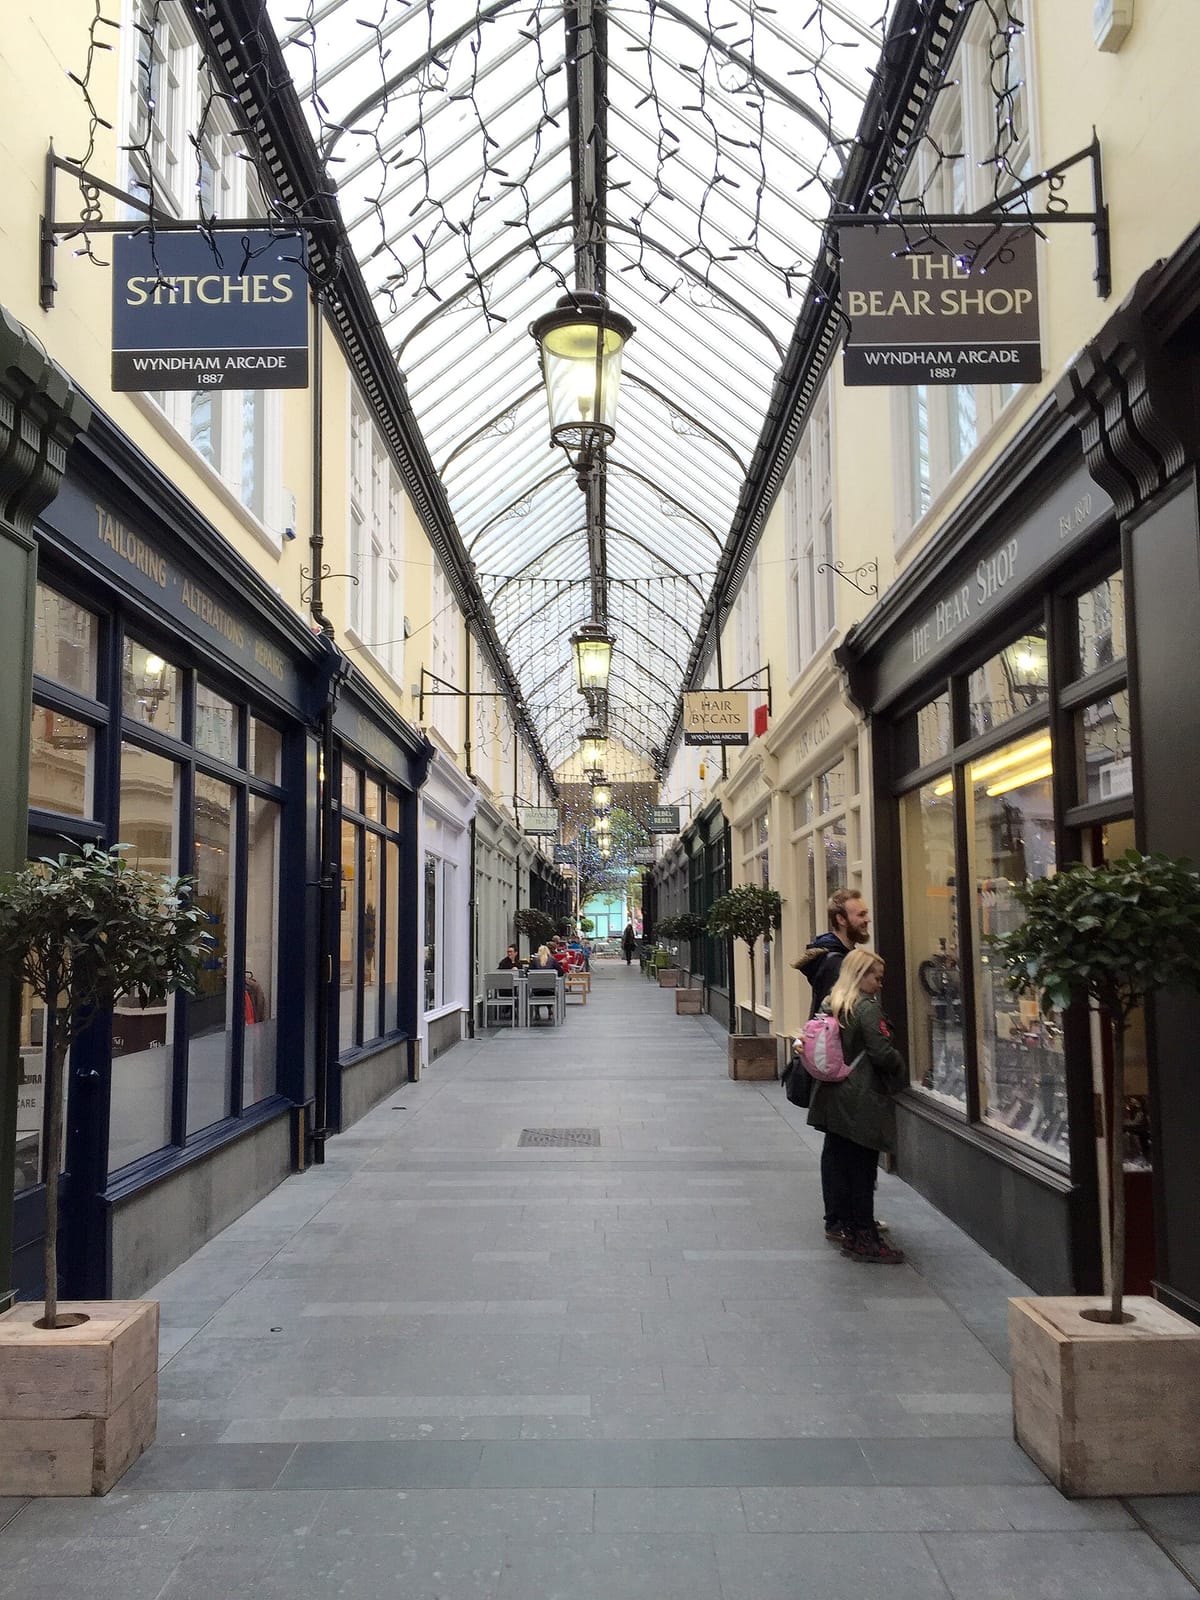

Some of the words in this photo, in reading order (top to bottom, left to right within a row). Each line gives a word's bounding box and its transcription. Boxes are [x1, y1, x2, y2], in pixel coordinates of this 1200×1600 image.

[126, 274, 293, 306] STITCHES
[848, 290, 936, 317] BEAR
[940, 288, 1032, 316] SHOP
[133, 357, 220, 370] WYNDHAM
[225, 356, 287, 369] ARCADE
[864, 351, 953, 365] WYNDHAM
[957, 350, 1020, 363] ARCADE
[197, 374, 224, 384] 1887
[930, 368, 957, 378] 1887
[95, 503, 167, 588] TAILORING
[181, 578, 244, 649] ALTERATIONS
[911, 623, 930, 663] THE
[935, 585, 971, 642] BEAR
[976, 538, 1018, 606] SHOP
[701, 700, 733, 711] HAIR
[710, 713, 741, 724] CATS
